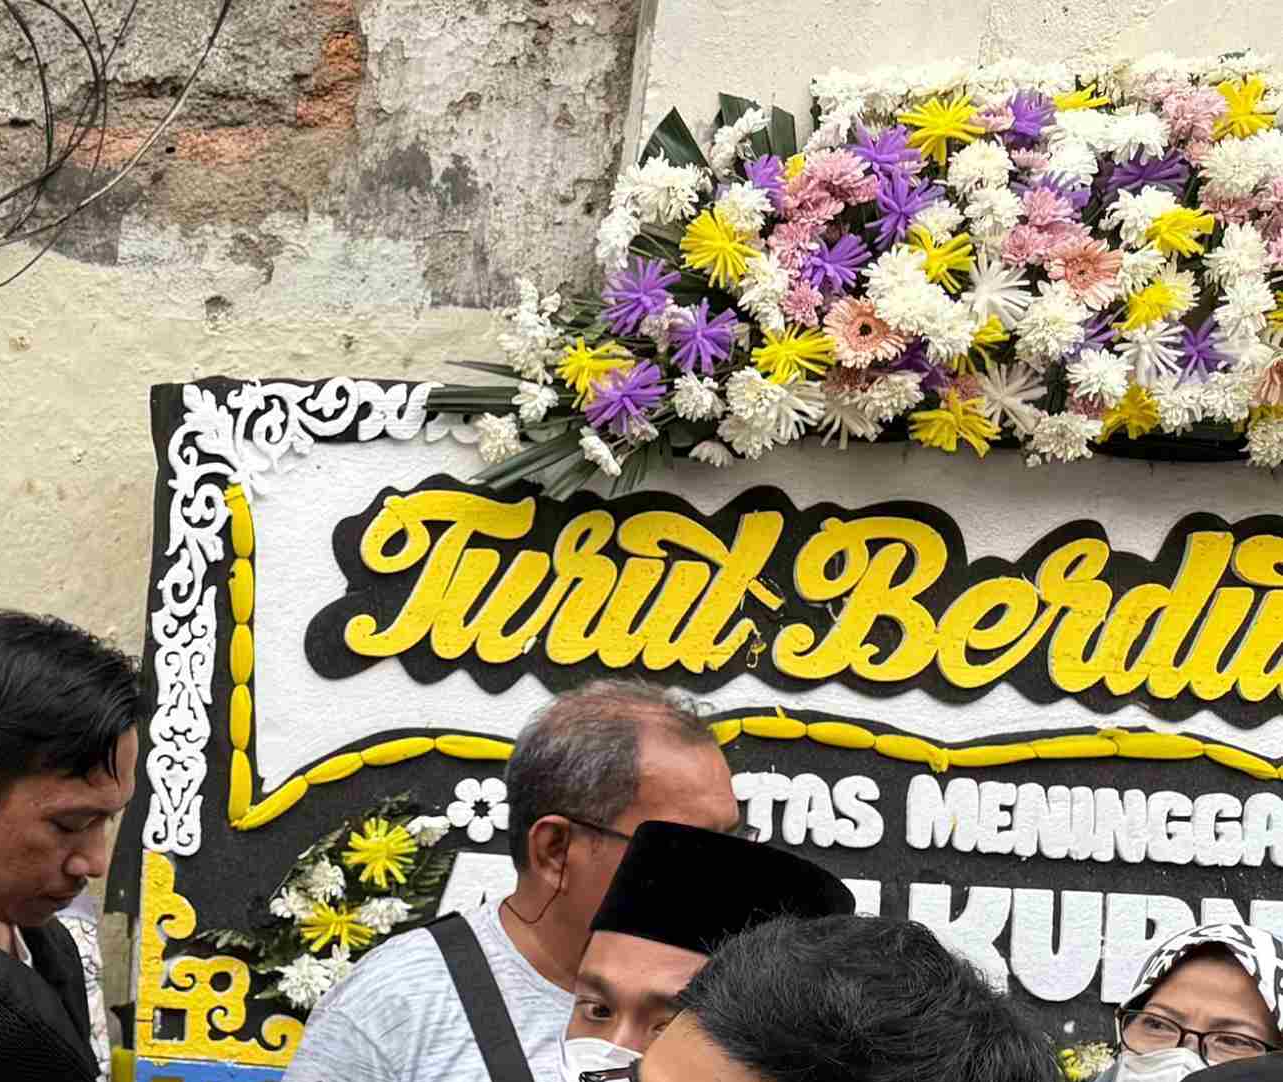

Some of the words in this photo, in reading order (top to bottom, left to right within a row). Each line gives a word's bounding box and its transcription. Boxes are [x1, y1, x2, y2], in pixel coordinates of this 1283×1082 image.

[344, 489, 784, 673] Turut
[771, 515, 1283, 702] Berdu
[730, 770, 886, 850] TAS
